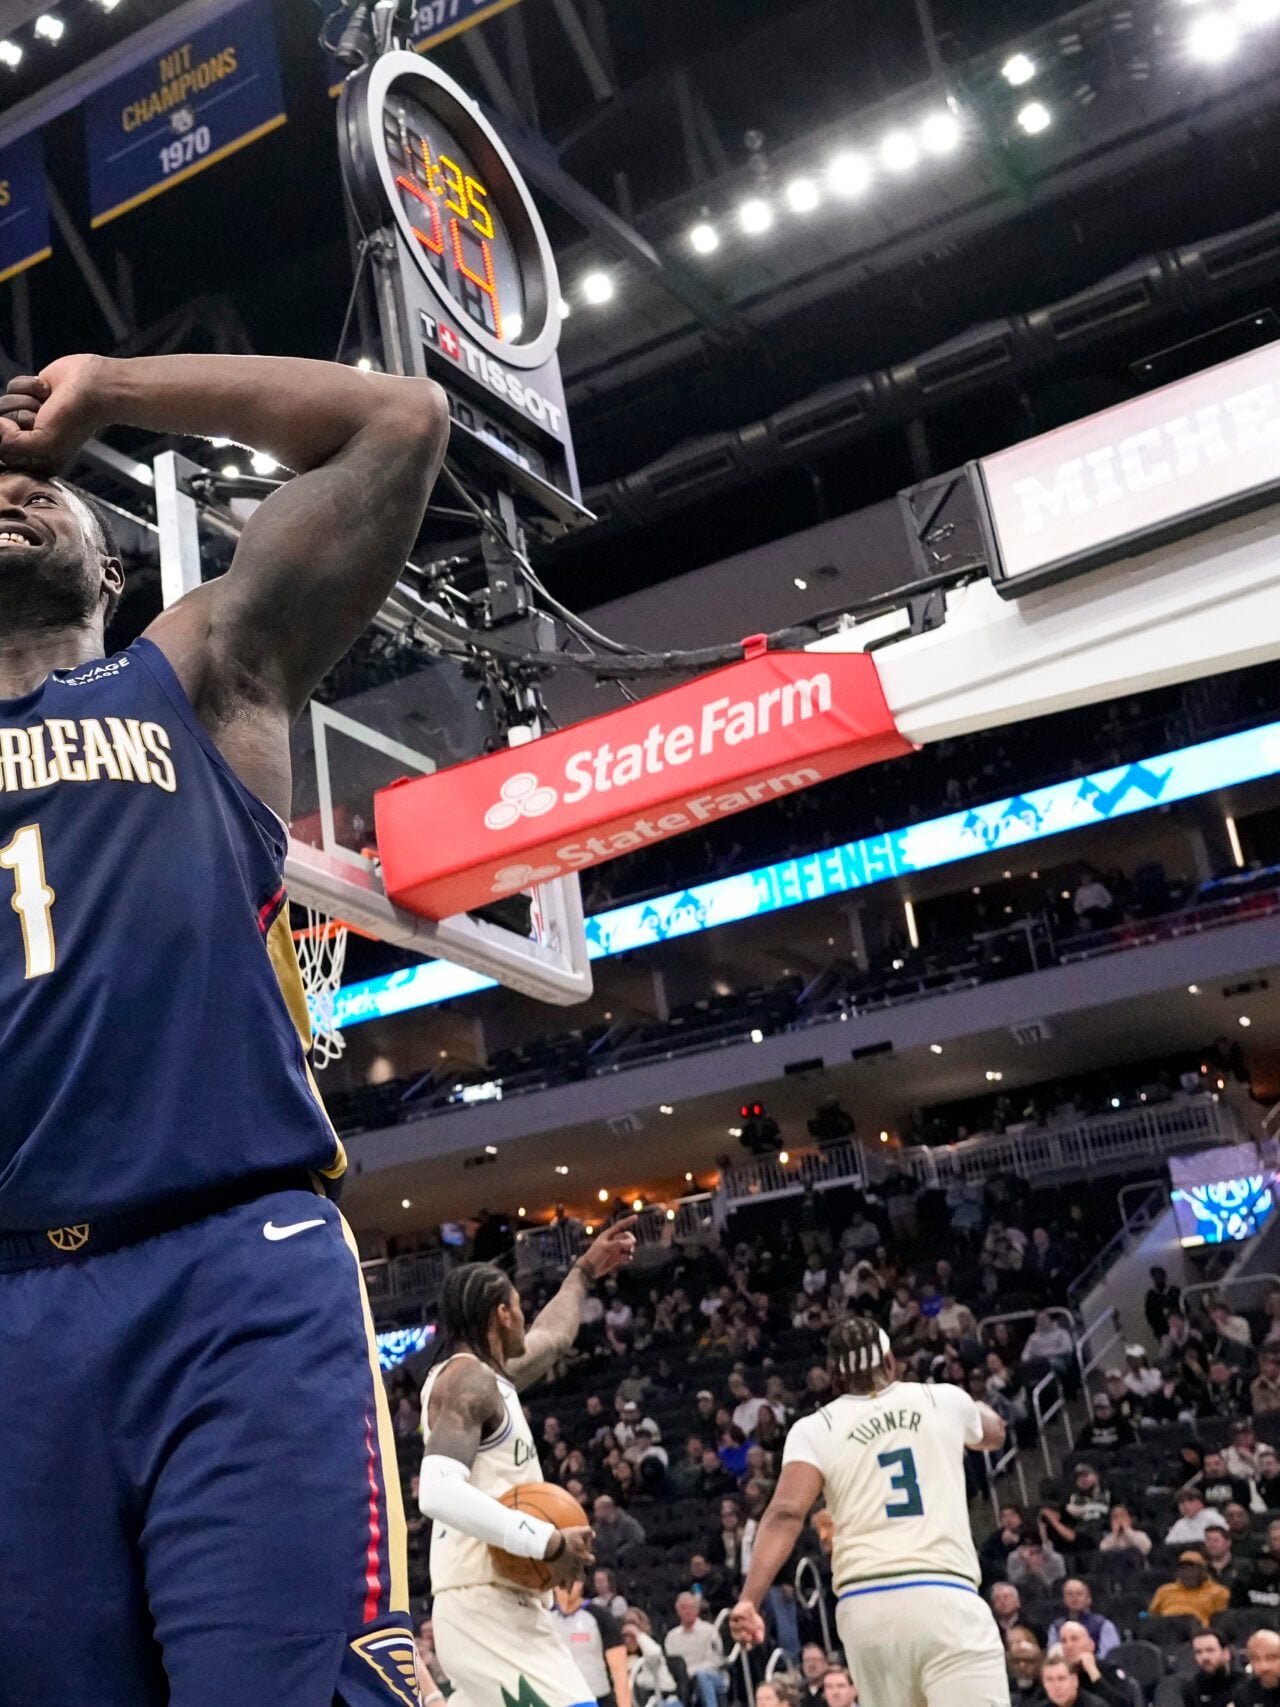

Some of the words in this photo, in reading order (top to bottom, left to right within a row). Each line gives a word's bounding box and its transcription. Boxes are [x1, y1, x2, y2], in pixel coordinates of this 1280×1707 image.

[122, 47, 238, 132] CHAMPIONS
[158, 43, 194, 80] NIT
[158, 126, 211, 174] 1970
[458, 336, 561, 433] TISSOT
[752, 829, 917, 914] DEFENSE
[847, 1409, 922, 1445] TURNER
[877, 1447, 925, 1518] 3
[519, 1520, 536, 1535] 7
